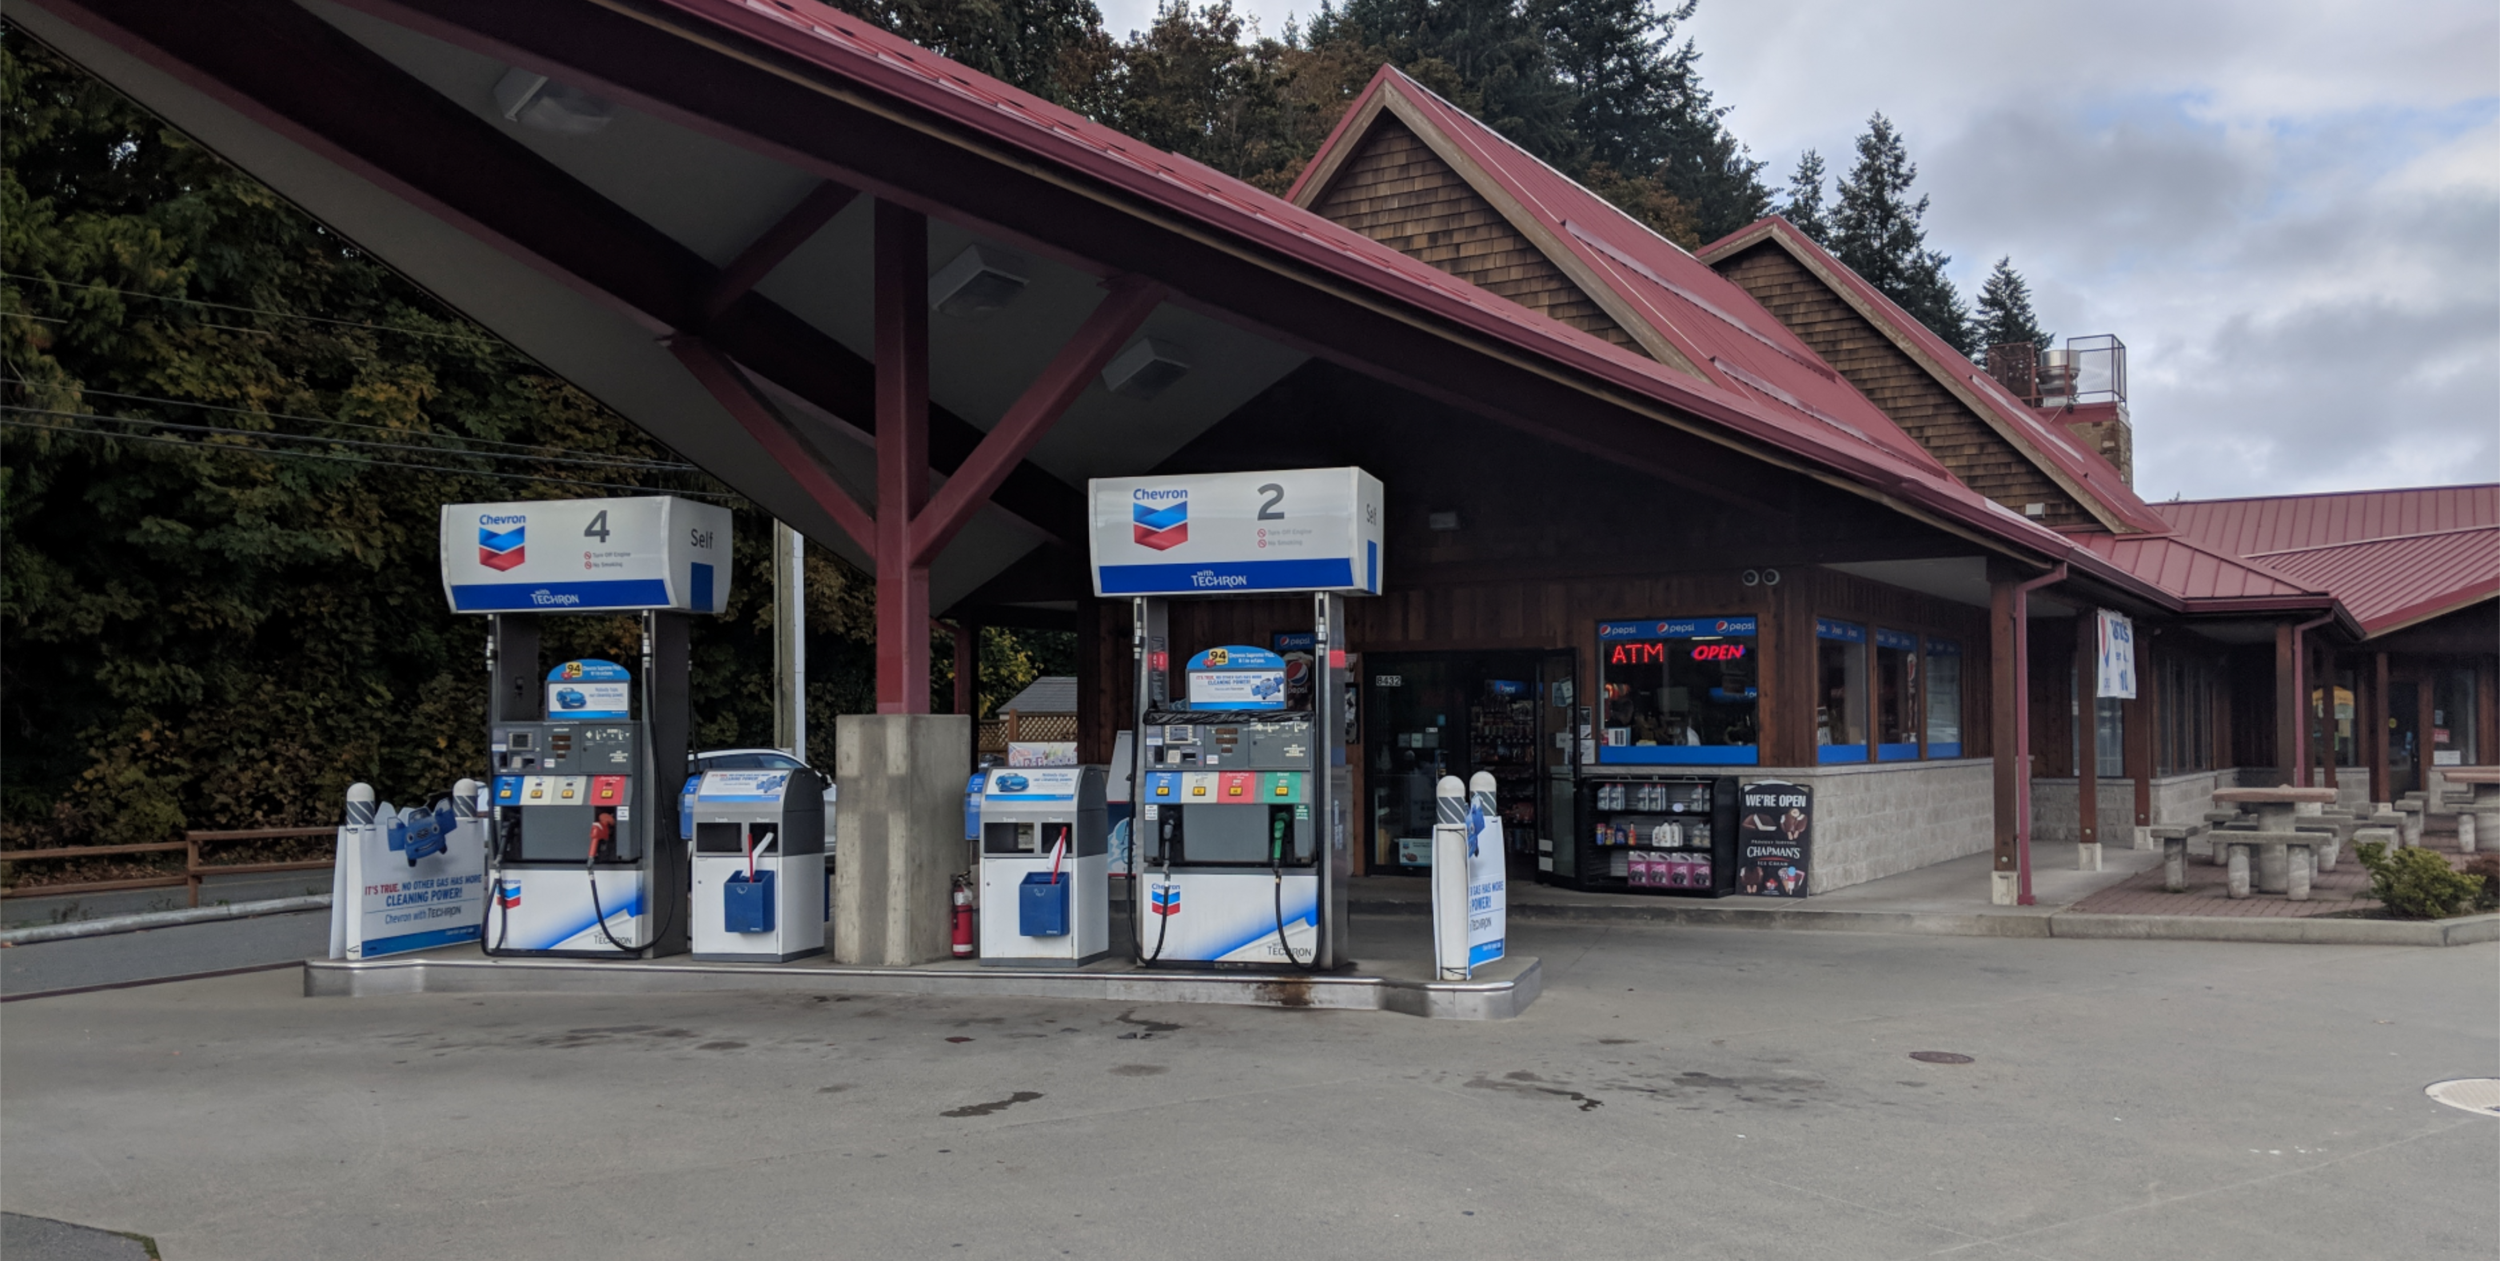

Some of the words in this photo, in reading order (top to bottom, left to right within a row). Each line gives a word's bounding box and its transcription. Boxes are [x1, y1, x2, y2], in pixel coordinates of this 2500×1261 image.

[1132, 488, 1189, 501] Chevron
[1256, 483, 1285, 521] 2
[478, 513, 527, 526] Chevron
[1366, 503, 1377, 526] Self
[583, 509, 611, 544] 4
[690, 528, 714, 550] Self
[1196, 569, 1214, 577] with
[1190, 574, 1248, 588] TECHRON
[529, 592, 580, 606] TECHRON
[1612, 625, 1637, 636] pepsi
[1669, 622, 1695, 634] pepsi
[1729, 620, 1755, 632] pepsi
[1290, 637, 1311, 646] pepsi
[1210, 651, 1226, 659] 94
[1611, 642, 1665, 665] ATM
[1692, 644, 1745, 661] OPEN
[1376, 675, 1401, 687] 8432
[1745, 793, 1777, 807] WE'RE
[1778, 794, 1807, 808] OPEN
[1746, 845, 1801, 860] CHAPMAN'S
[364, 885, 379, 896] IT'S
[380, 883, 400, 895] TRUE.
[401, 882, 412, 892] NO
[413, 879, 435, 890] OTHER
[436, 878, 449, 888] GAS
[450, 876, 464, 886] HAS
[465, 873, 483, 884] MORE
[1482, 882, 1492, 894] HAS
[1492, 880, 1504, 893] MORE
[386, 892, 429, 908] CLEANING
[431, 887, 463, 901] POWER!
[1472, 896, 1492, 911] POWER!
[385, 913, 412, 925] Chevron
[413, 910, 427, 920] with
[427, 906, 462, 919] TECHRON
[593, 934, 633, 946] TECRON
[1266, 945, 1312, 958] TECRON
